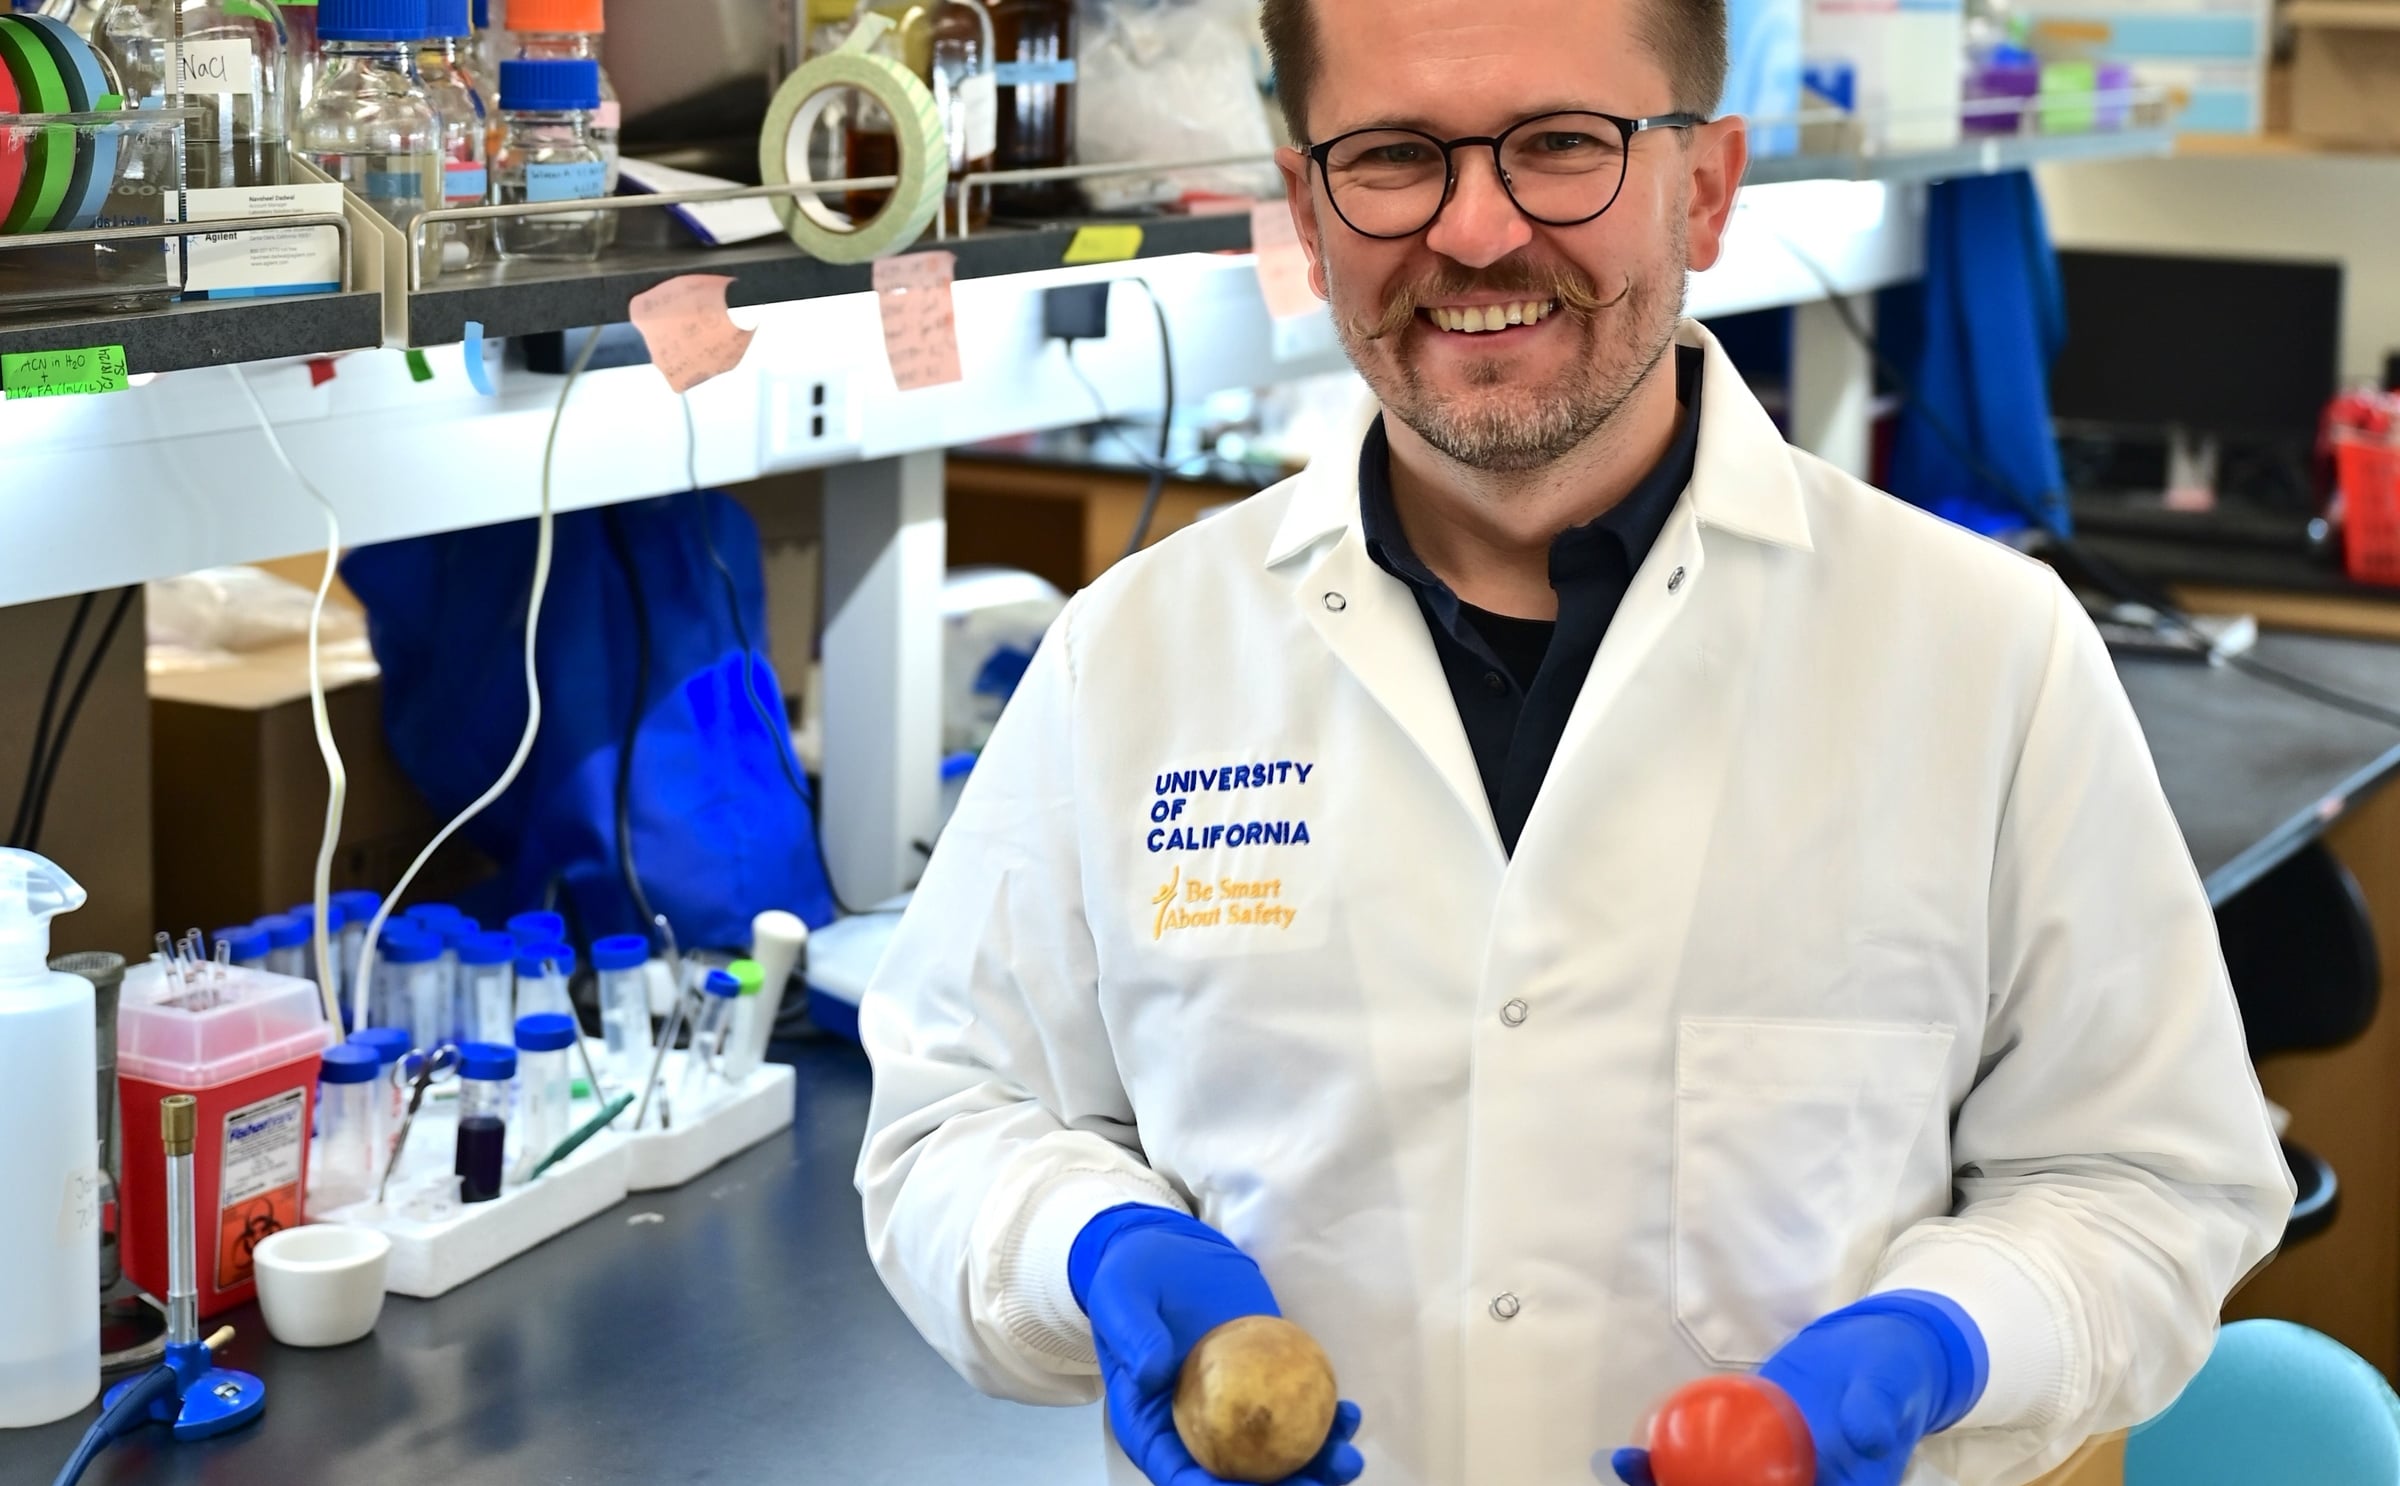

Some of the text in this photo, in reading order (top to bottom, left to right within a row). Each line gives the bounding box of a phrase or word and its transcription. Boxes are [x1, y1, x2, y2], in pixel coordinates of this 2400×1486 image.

[182, 54, 227, 82] NaCl
[205, 232, 237, 244] Agilent
[21, 358, 47, 373] ACN
[51, 359, 60, 368] in
[37, 385, 53, 397] FA
[1155, 761, 1313, 796] UNIVERSITY
[1150, 798, 1187, 823] OF
[1147, 821, 1310, 852] CALIFORNIA
[1186, 877, 1281, 903] Be Smart
[1164, 901, 1297, 931] About Safety
